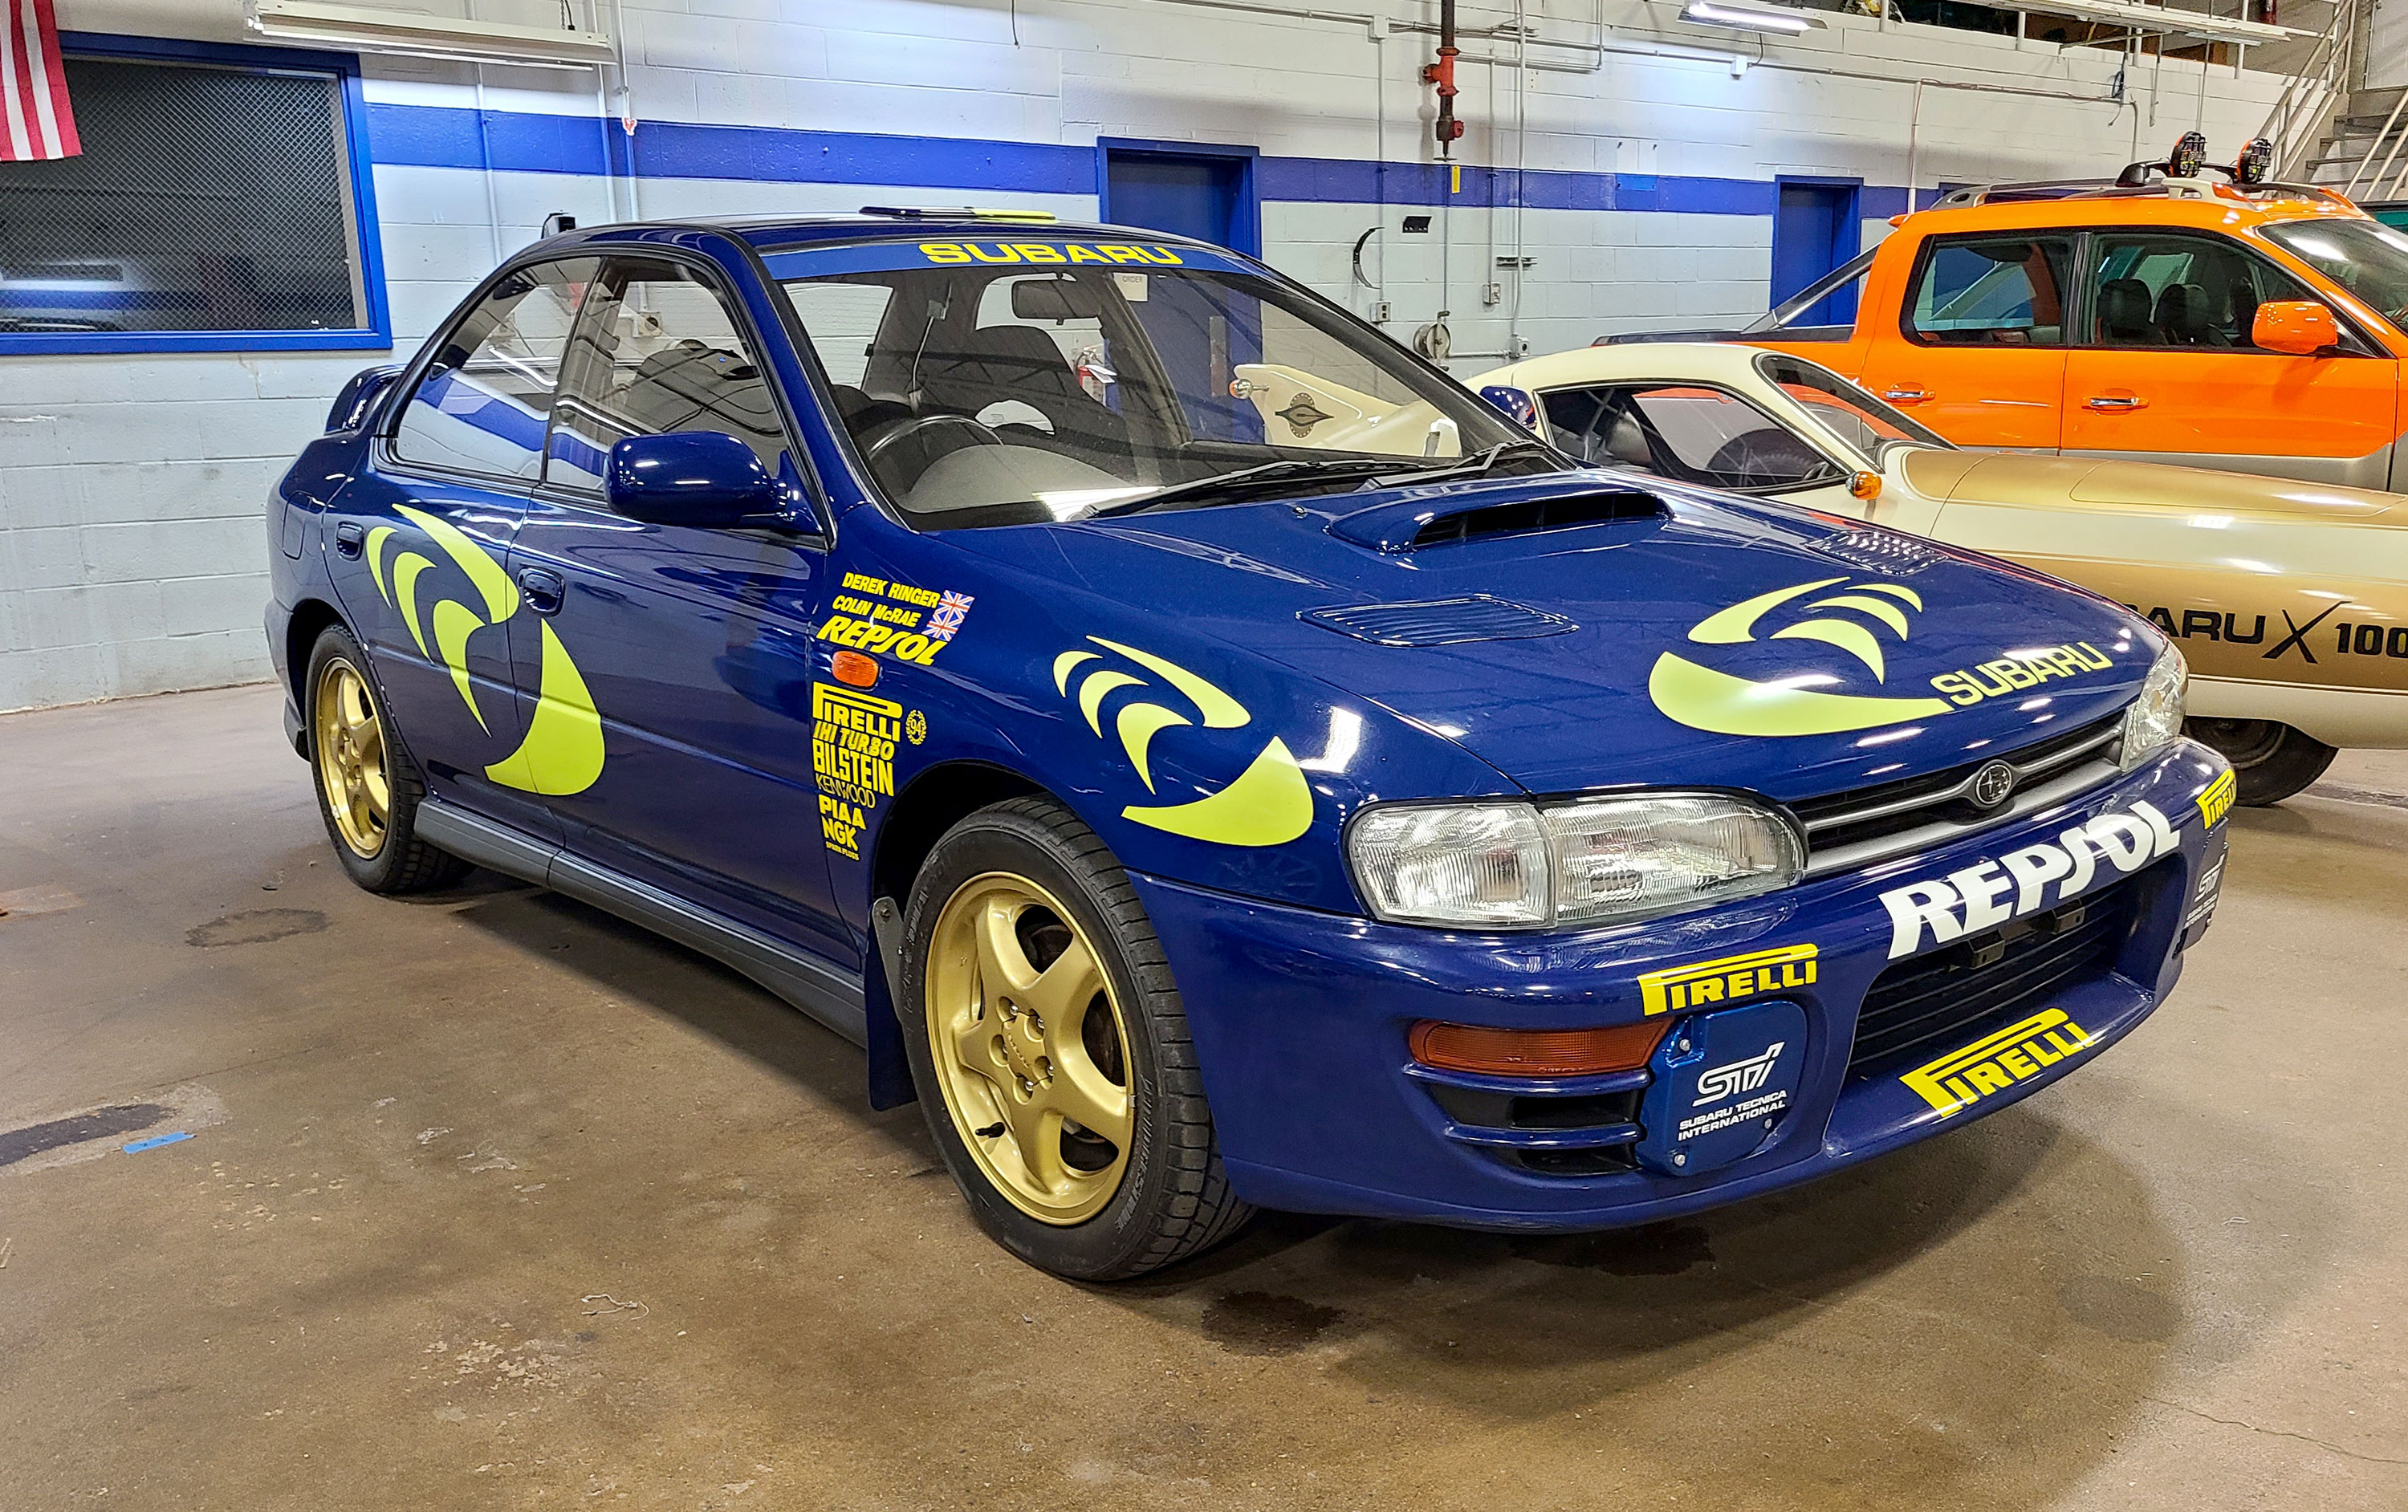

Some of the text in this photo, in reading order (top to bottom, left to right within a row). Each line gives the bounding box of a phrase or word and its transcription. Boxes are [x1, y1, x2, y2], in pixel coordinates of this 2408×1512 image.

[918, 244, 1184, 264] SUBARU
[842, 572, 942, 608] DEREK RINGER
[832, 595, 922, 628] COLIN McRAE
[816, 615, 948, 666] REPSOL
[2261, 601, 2353, 665] X
[1930, 641, 2113, 707] SUBARU
[812, 681, 903, 742] PIRELLI
[813, 720, 895, 761] IHI TURBO
[812, 738, 894, 797] BILSTEIN
[816, 772, 876, 809] KENWOOD
[818, 794, 867, 830] PIAA
[821, 815, 859, 851] NGK
[1879, 799, 2181, 960] REPSOL
[1637, 942, 1818, 1016] PIRELLI
[1899, 1008, 2095, 1118] PIRELLI
[1678, 1100, 1786, 1141] INTERNATIONAL
[1679, 1090, 1788, 1130] SUBARU TECNICA
